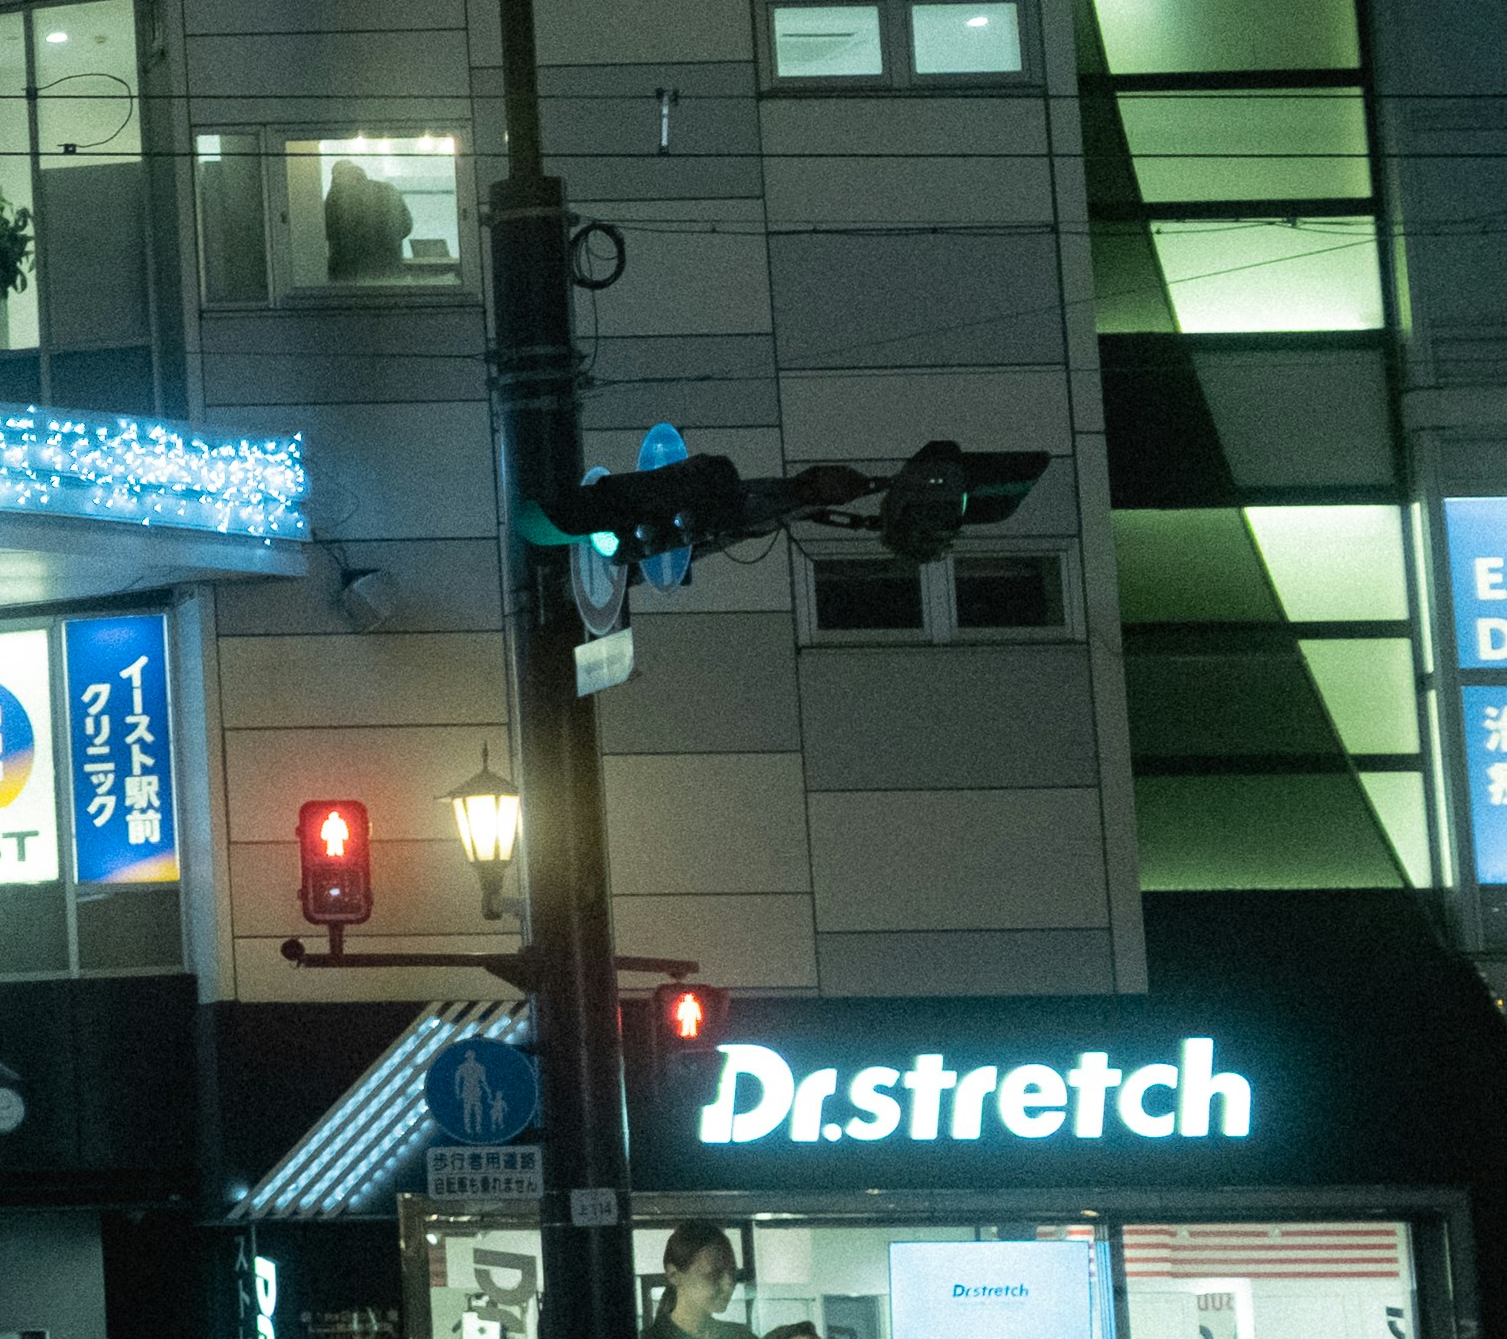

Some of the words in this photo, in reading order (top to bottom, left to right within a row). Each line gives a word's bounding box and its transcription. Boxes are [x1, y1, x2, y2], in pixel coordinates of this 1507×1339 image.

[80, 681, 117, 829] クリニック
[119, 654, 161, 845] イースト駅前
[698, 1037, 1252, 1144] Dr.stretch
[433, 1151, 536, 1171] 歩行者用道路
